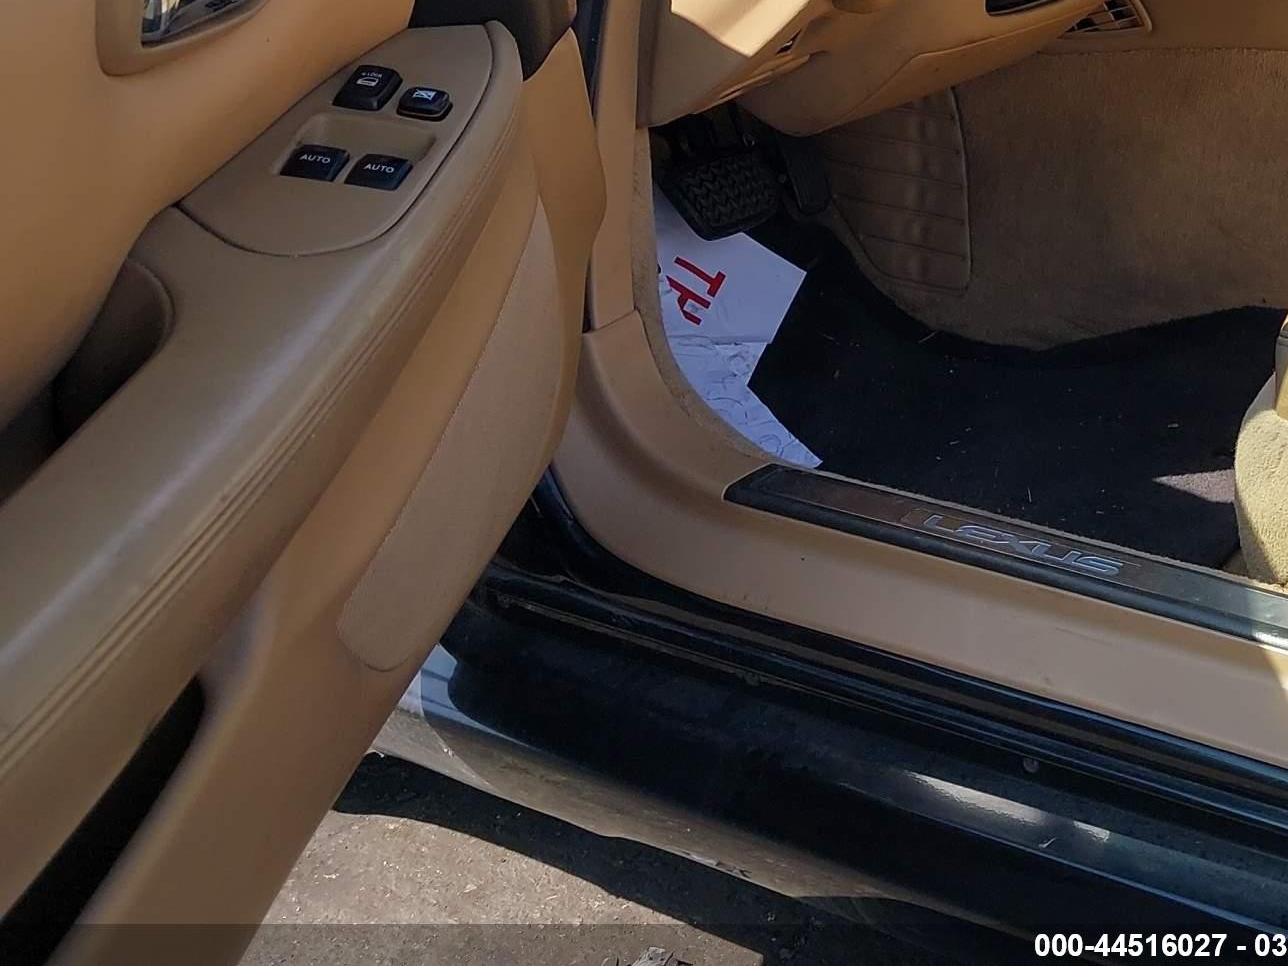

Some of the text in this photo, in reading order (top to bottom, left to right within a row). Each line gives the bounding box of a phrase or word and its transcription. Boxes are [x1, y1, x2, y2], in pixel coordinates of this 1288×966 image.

[299, 154, 331, 163] AUTO
[363, 163, 395, 173] AUTO
[922, 512, 1125, 576] LEXUS
